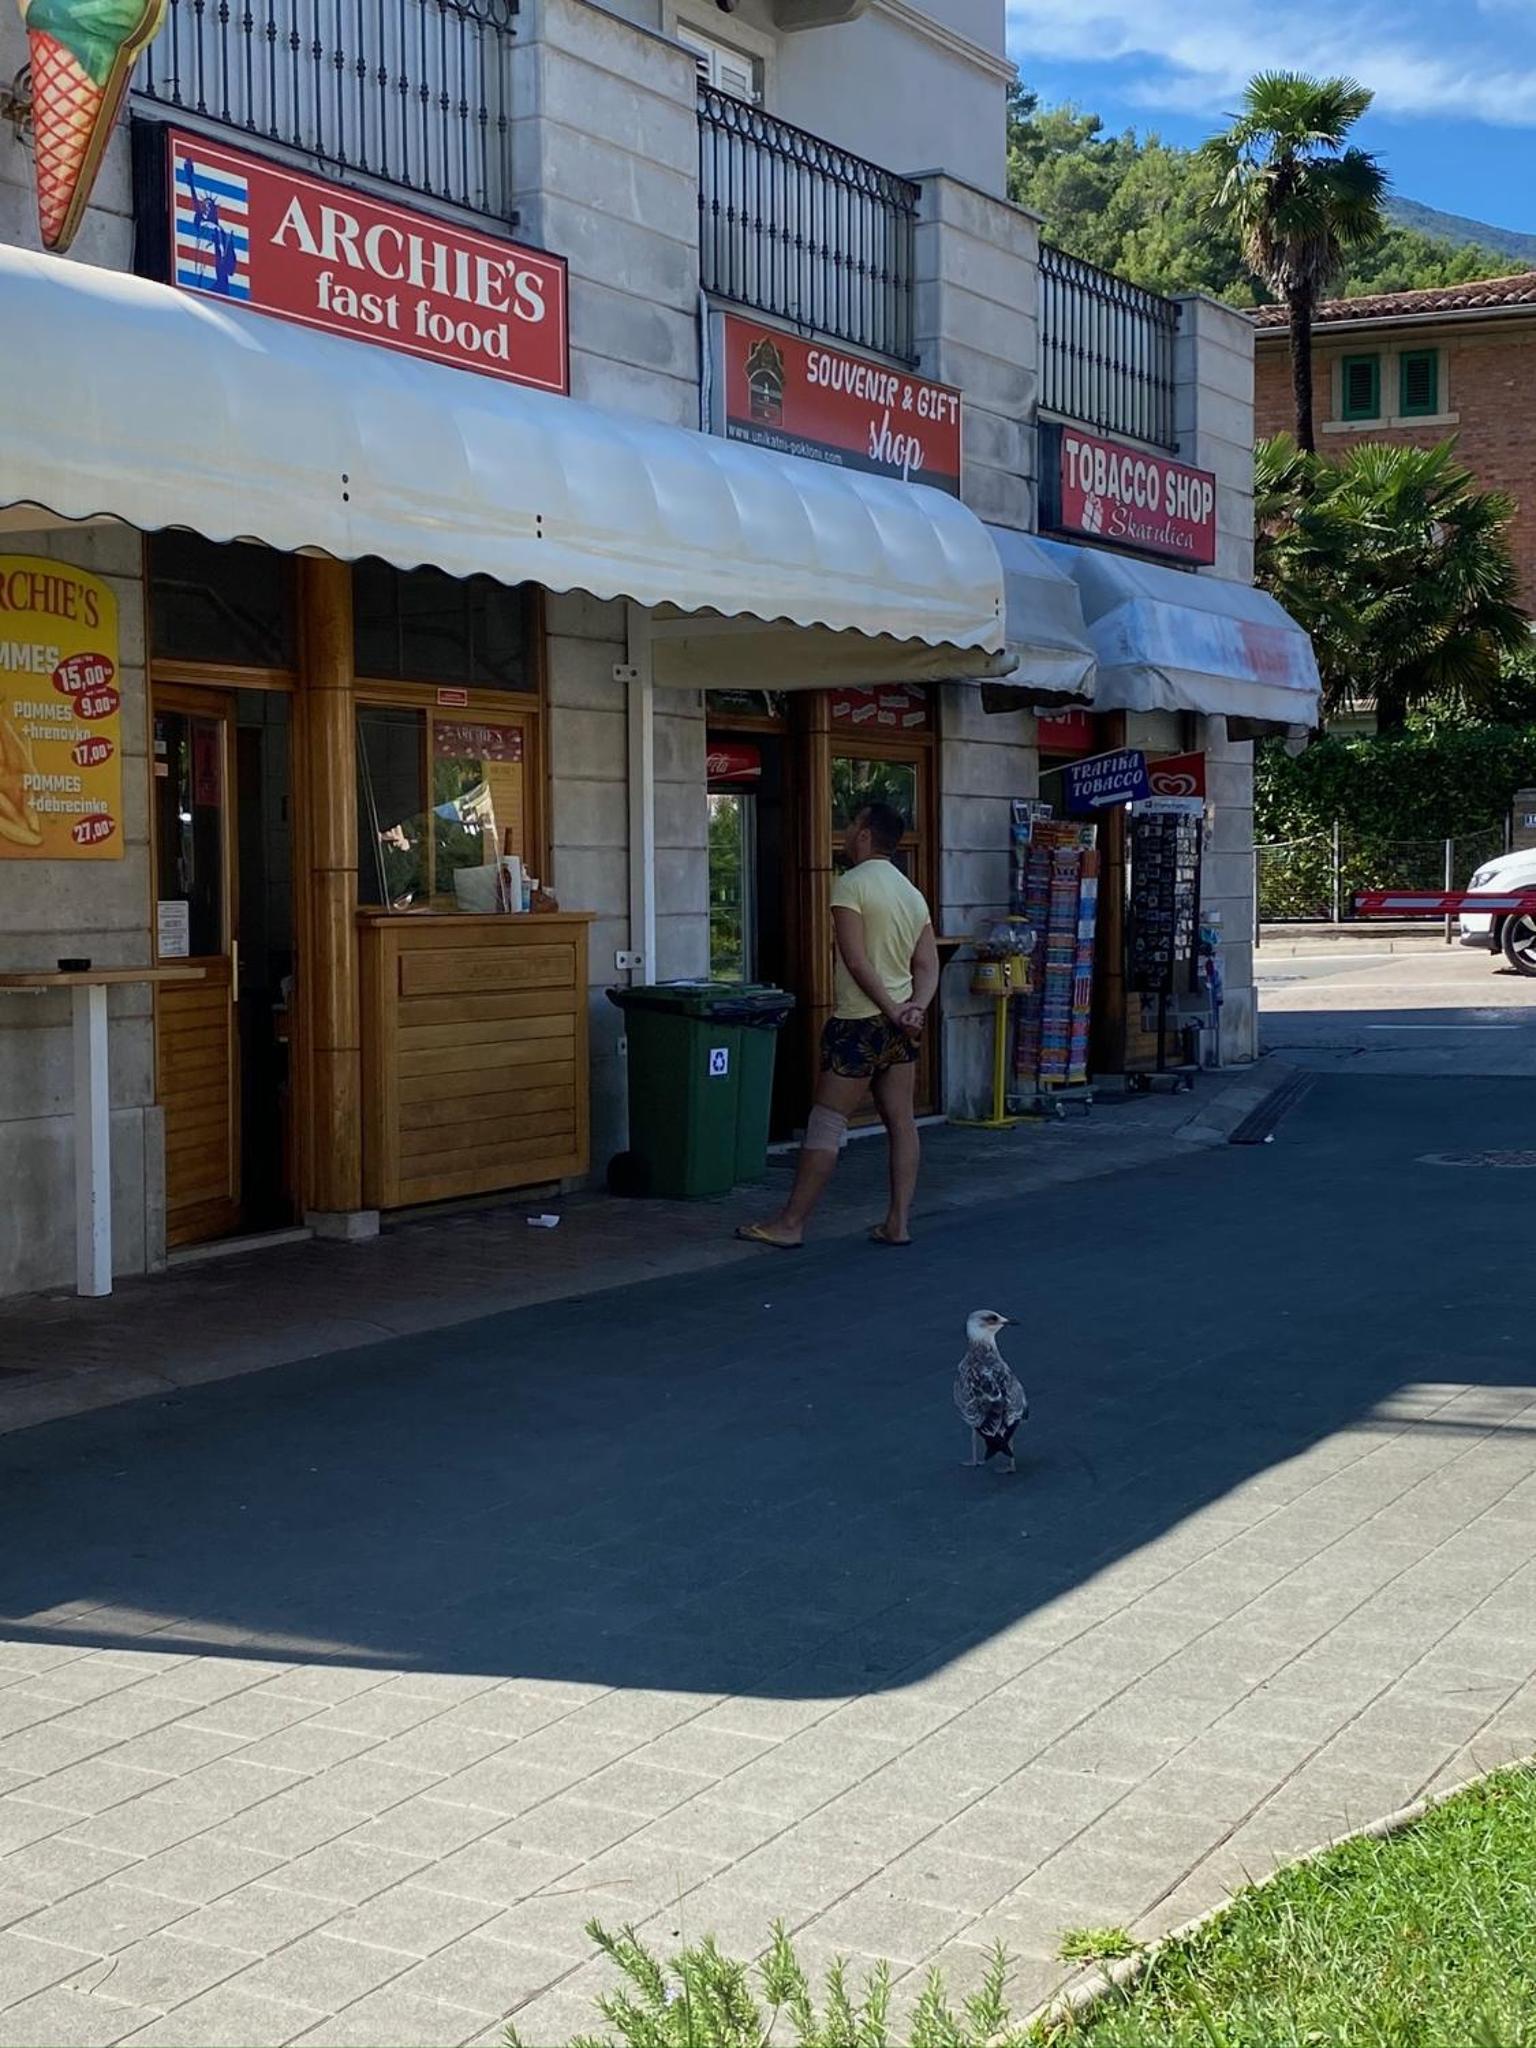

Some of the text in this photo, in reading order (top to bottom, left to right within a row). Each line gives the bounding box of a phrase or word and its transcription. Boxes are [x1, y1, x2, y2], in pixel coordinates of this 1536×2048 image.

[270, 195, 546, 323] ARCHIE'S
[316, 271, 510, 361] fast food
[806, 351, 959, 425] SOUVENIR & GIFT
[868, 410, 925, 481] shop
[1066, 438, 1213, 525] TOBACCO SHOP
[14, 701, 73, 721] POMMES
[23, 774, 82, 793] POMMES
[1071, 752, 1139, 780] TRAFIKA
[1073, 769, 1143, 797] TOBACCO
